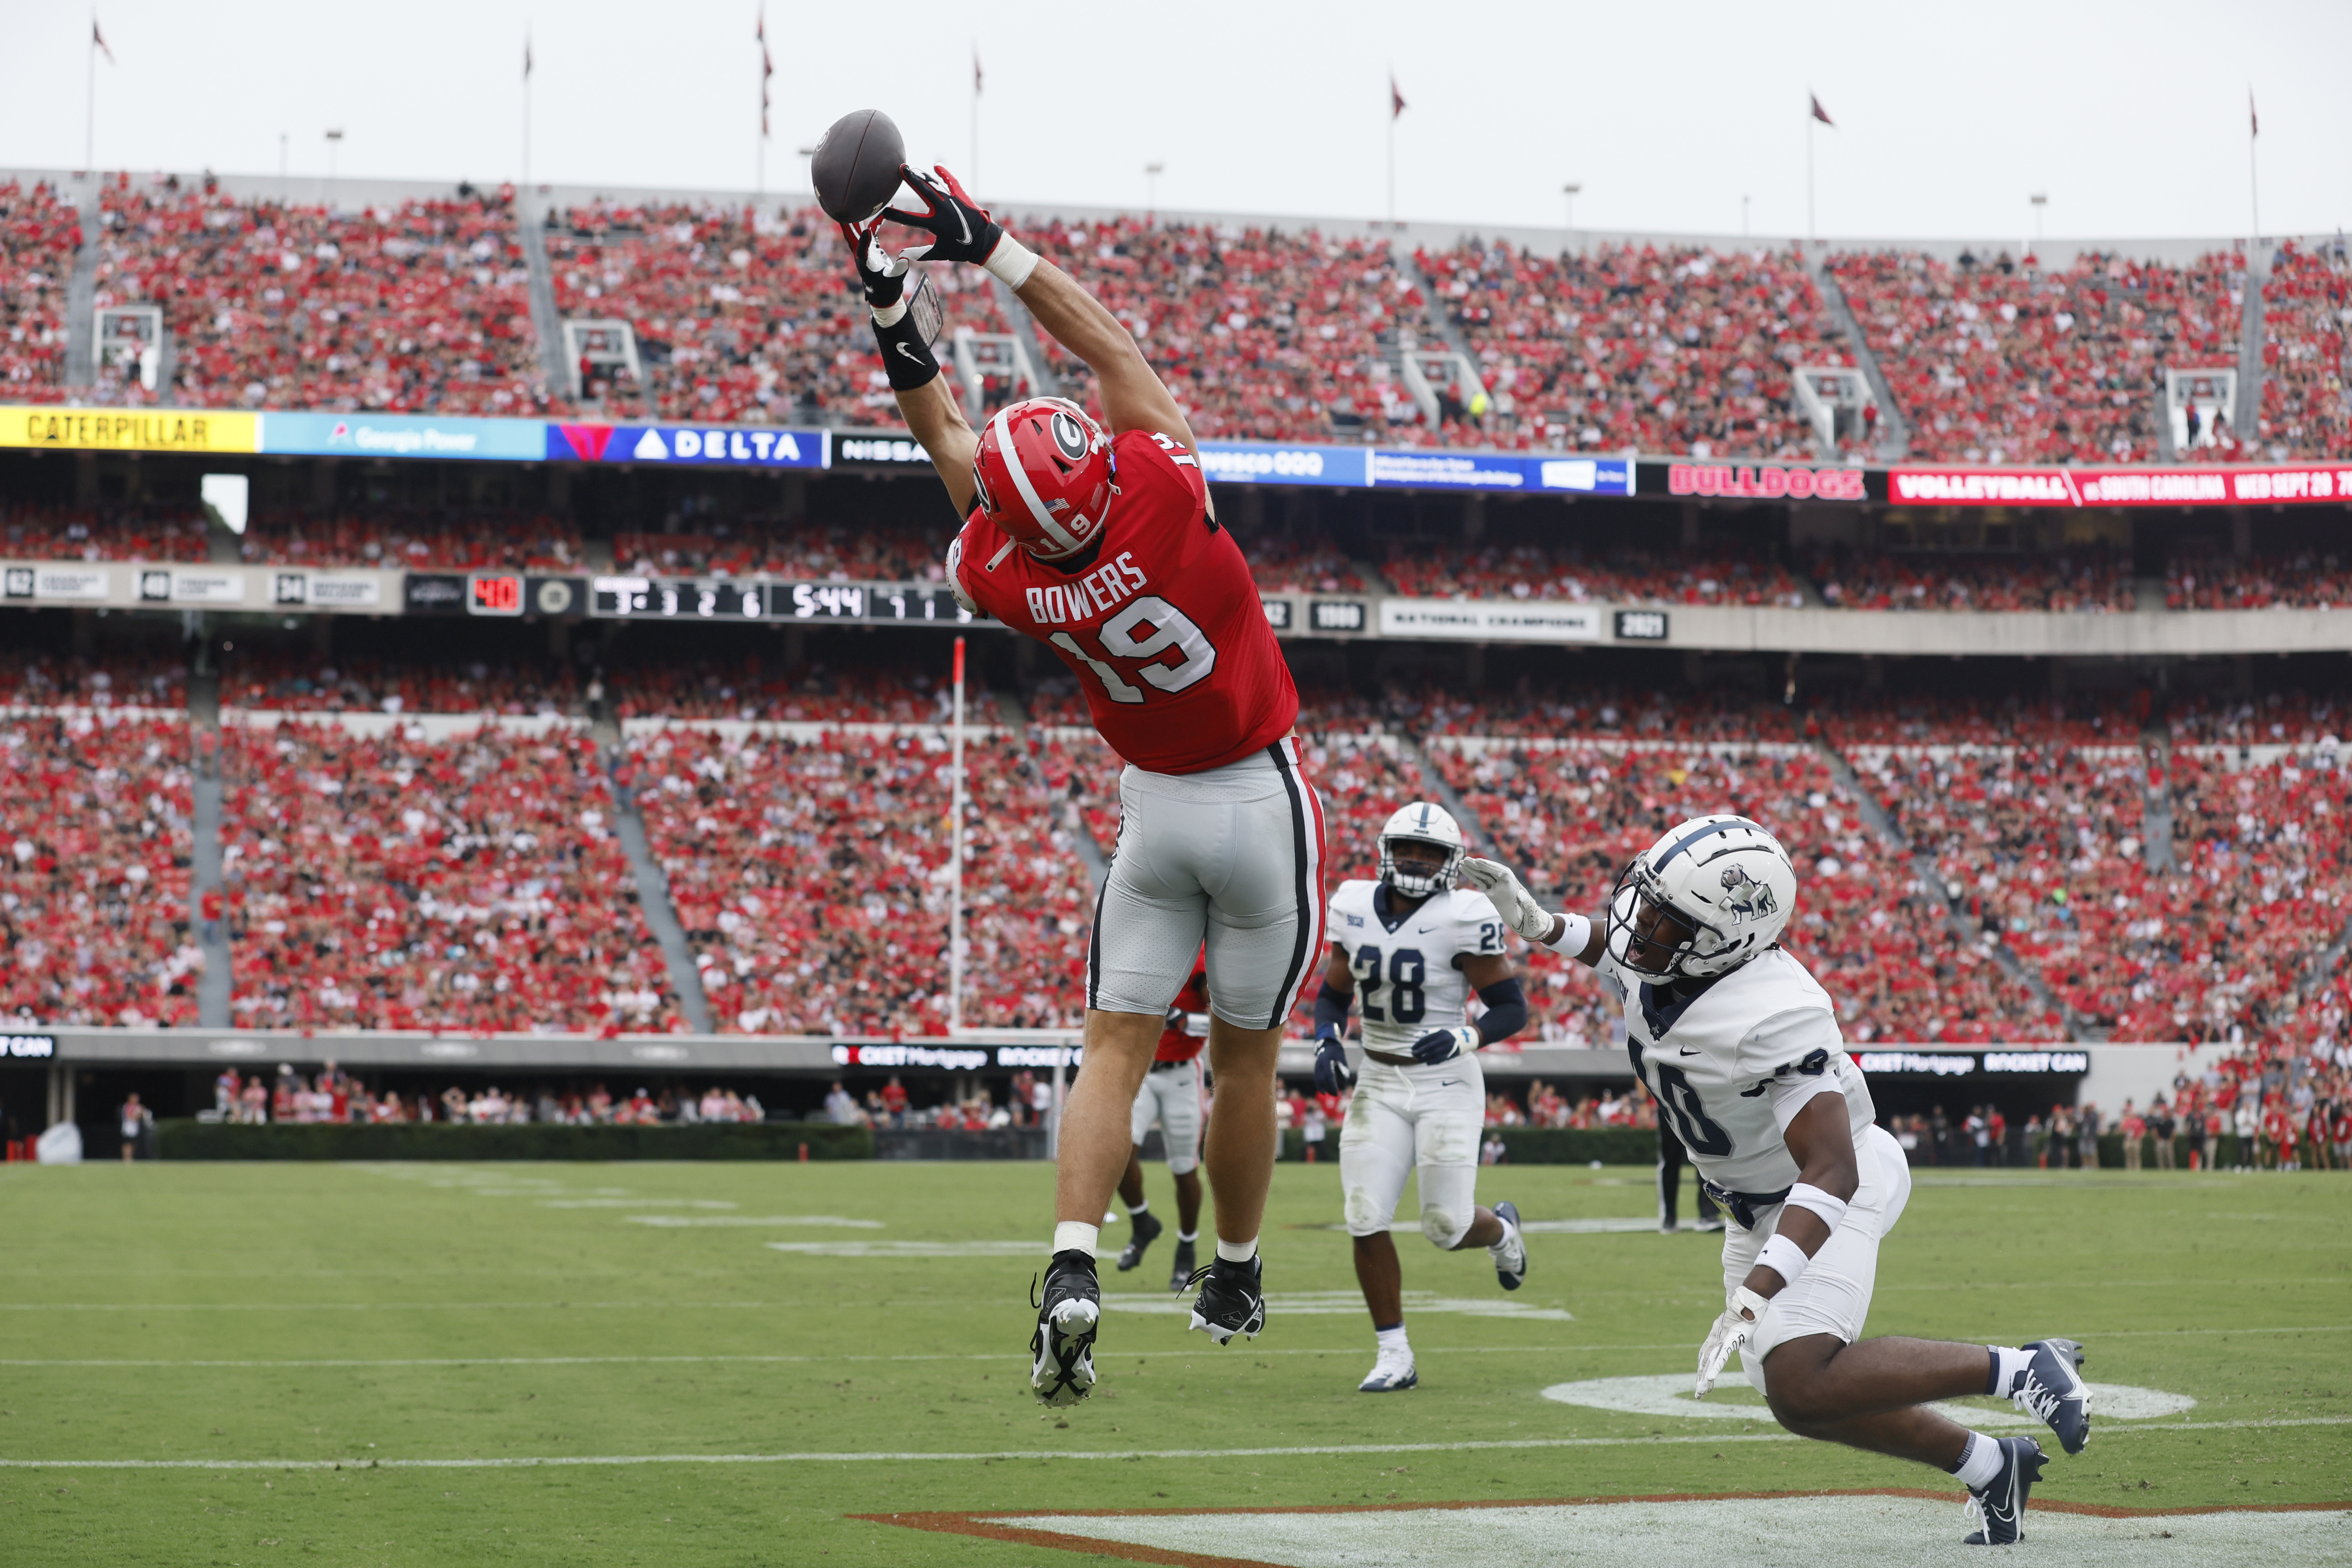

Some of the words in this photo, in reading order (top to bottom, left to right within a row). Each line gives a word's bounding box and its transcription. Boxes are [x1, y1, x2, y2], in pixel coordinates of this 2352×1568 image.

[28, 416, 209, 442] CATERPILLAR
[675, 429, 801, 461] DELTA
[842, 439, 932, 462] NISSA
[1668, 464, 1865, 500] BULLDOGS
[1897, 474, 2069, 500] VOLLEYBALL
[474, 576, 518, 612] 40
[793, 583, 862, 618] 5:44
[1026, 551, 1147, 624] BOWERS
[698, 591, 716, 617] 2
[742, 591, 761, 618] 6
[1488, 616, 1586, 629] CHAMPIONS
[1048, 594, 1218, 704] 19
[1355, 945, 1425, 1024] 28
[907, 1047, 988, 1070] Mortgage
[1904, 1053, 1976, 1076] Mortgage
[1984, 1052, 2050, 1072] ROCKET
[2050, 1052, 2087, 1073] CAN
